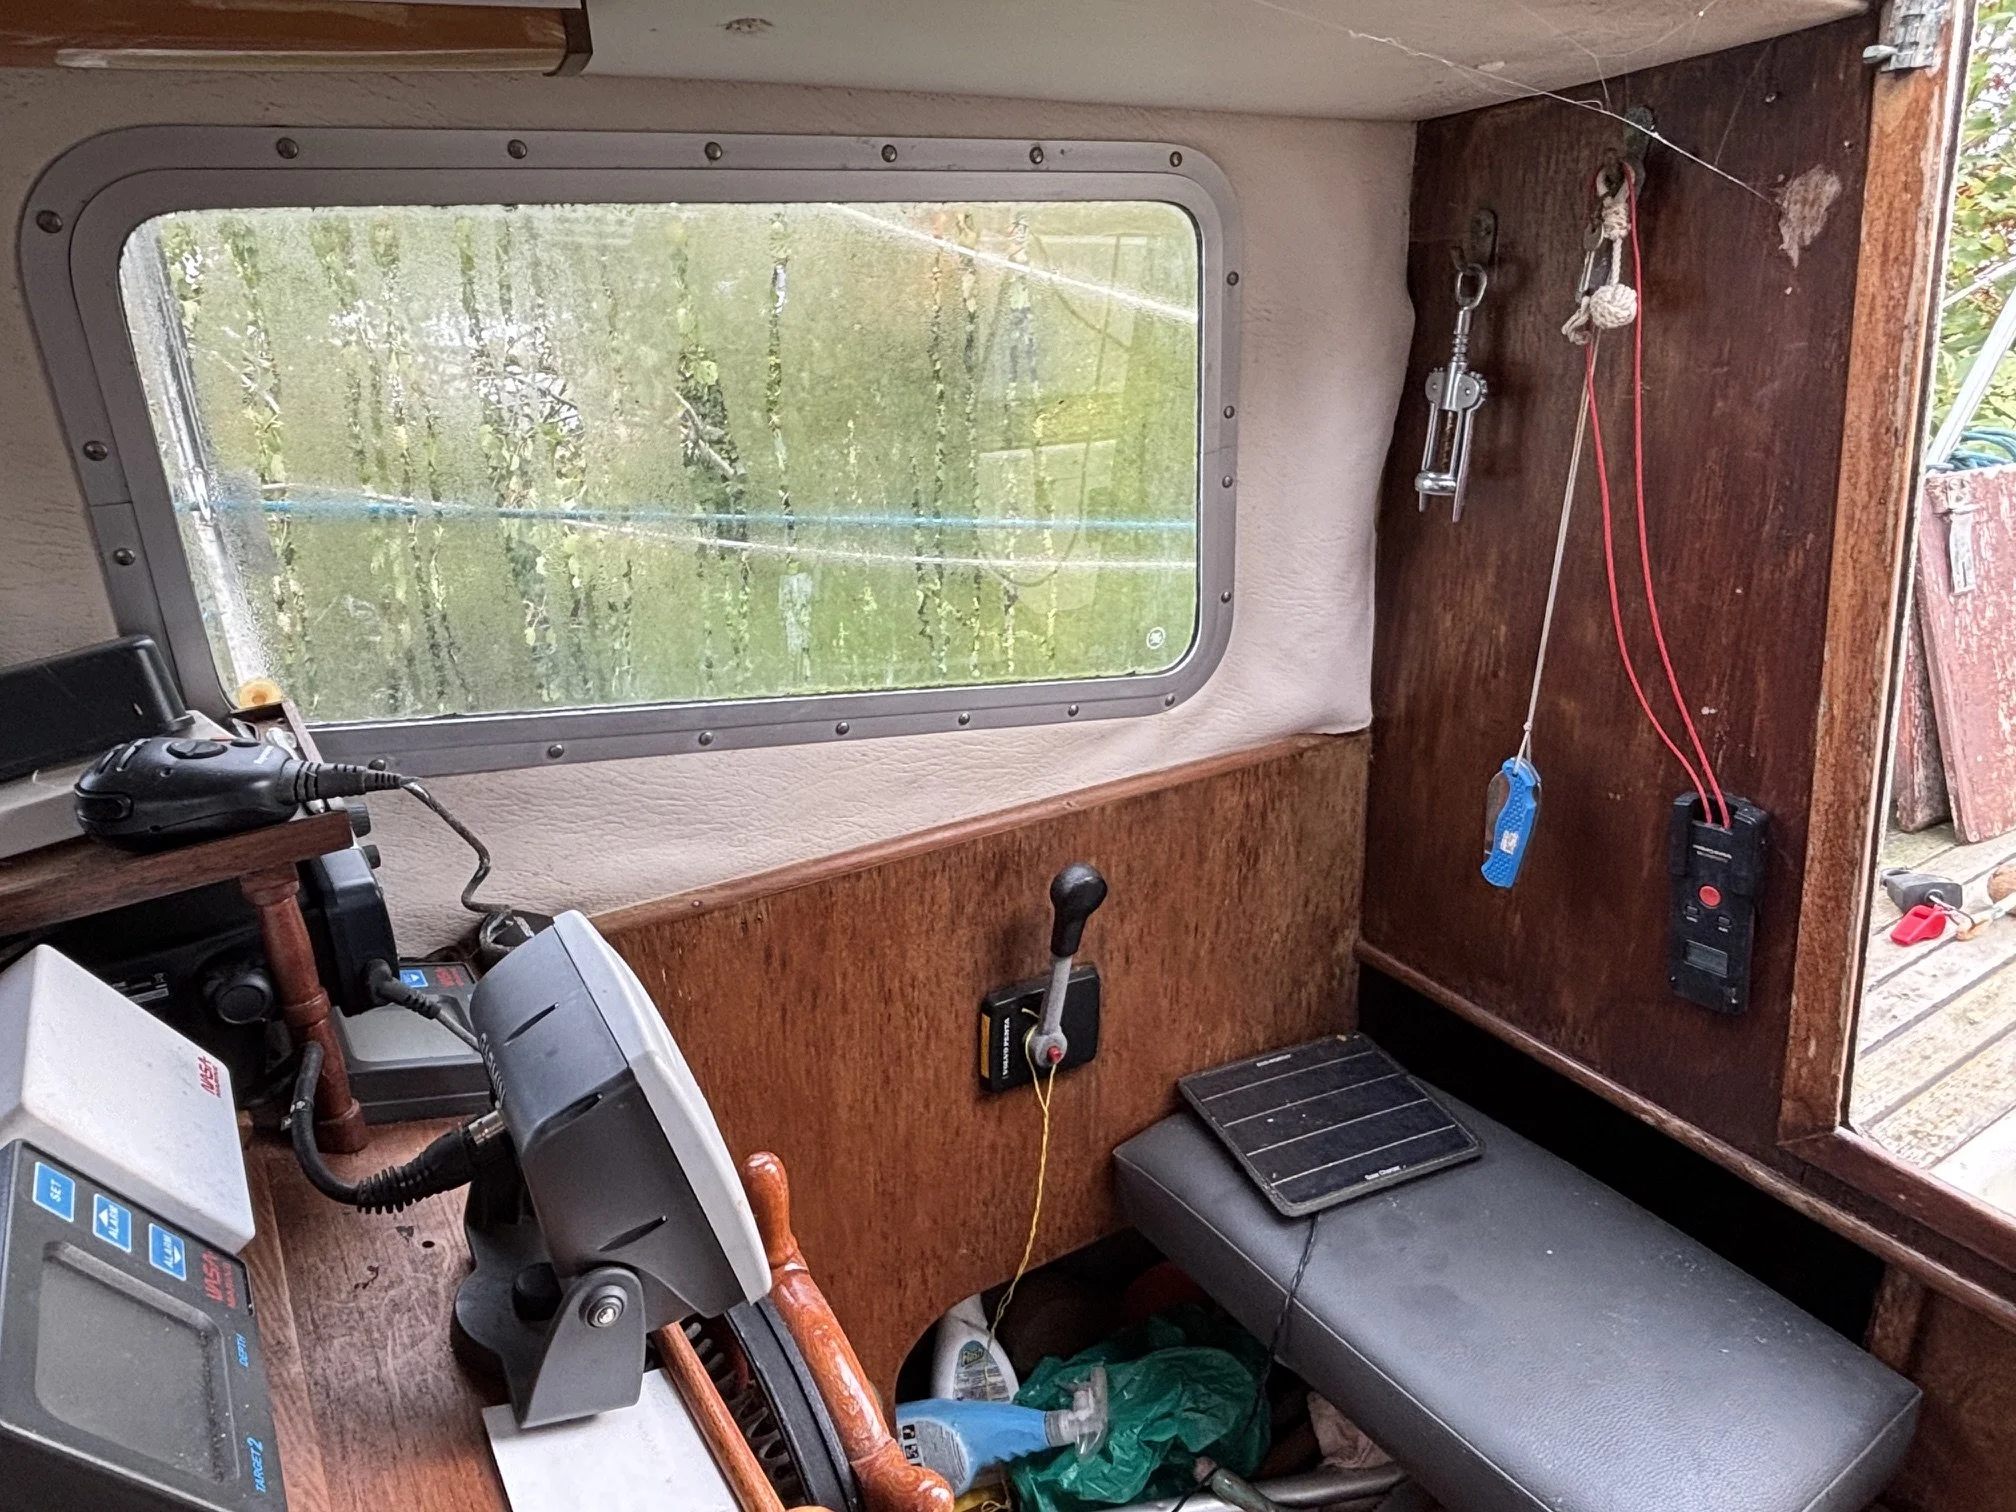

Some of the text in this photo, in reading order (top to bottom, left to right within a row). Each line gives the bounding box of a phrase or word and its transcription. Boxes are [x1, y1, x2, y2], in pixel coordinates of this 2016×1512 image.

[197, 1055, 215, 1095] NASA
[1002, 1046, 1010, 1076] VOLVO
[50, 1178, 62, 1203] SET
[108, 1204, 119, 1240] ALARM
[162, 1234, 174, 1269] ALARM
[235, 1332, 249, 1368] DEPTH
